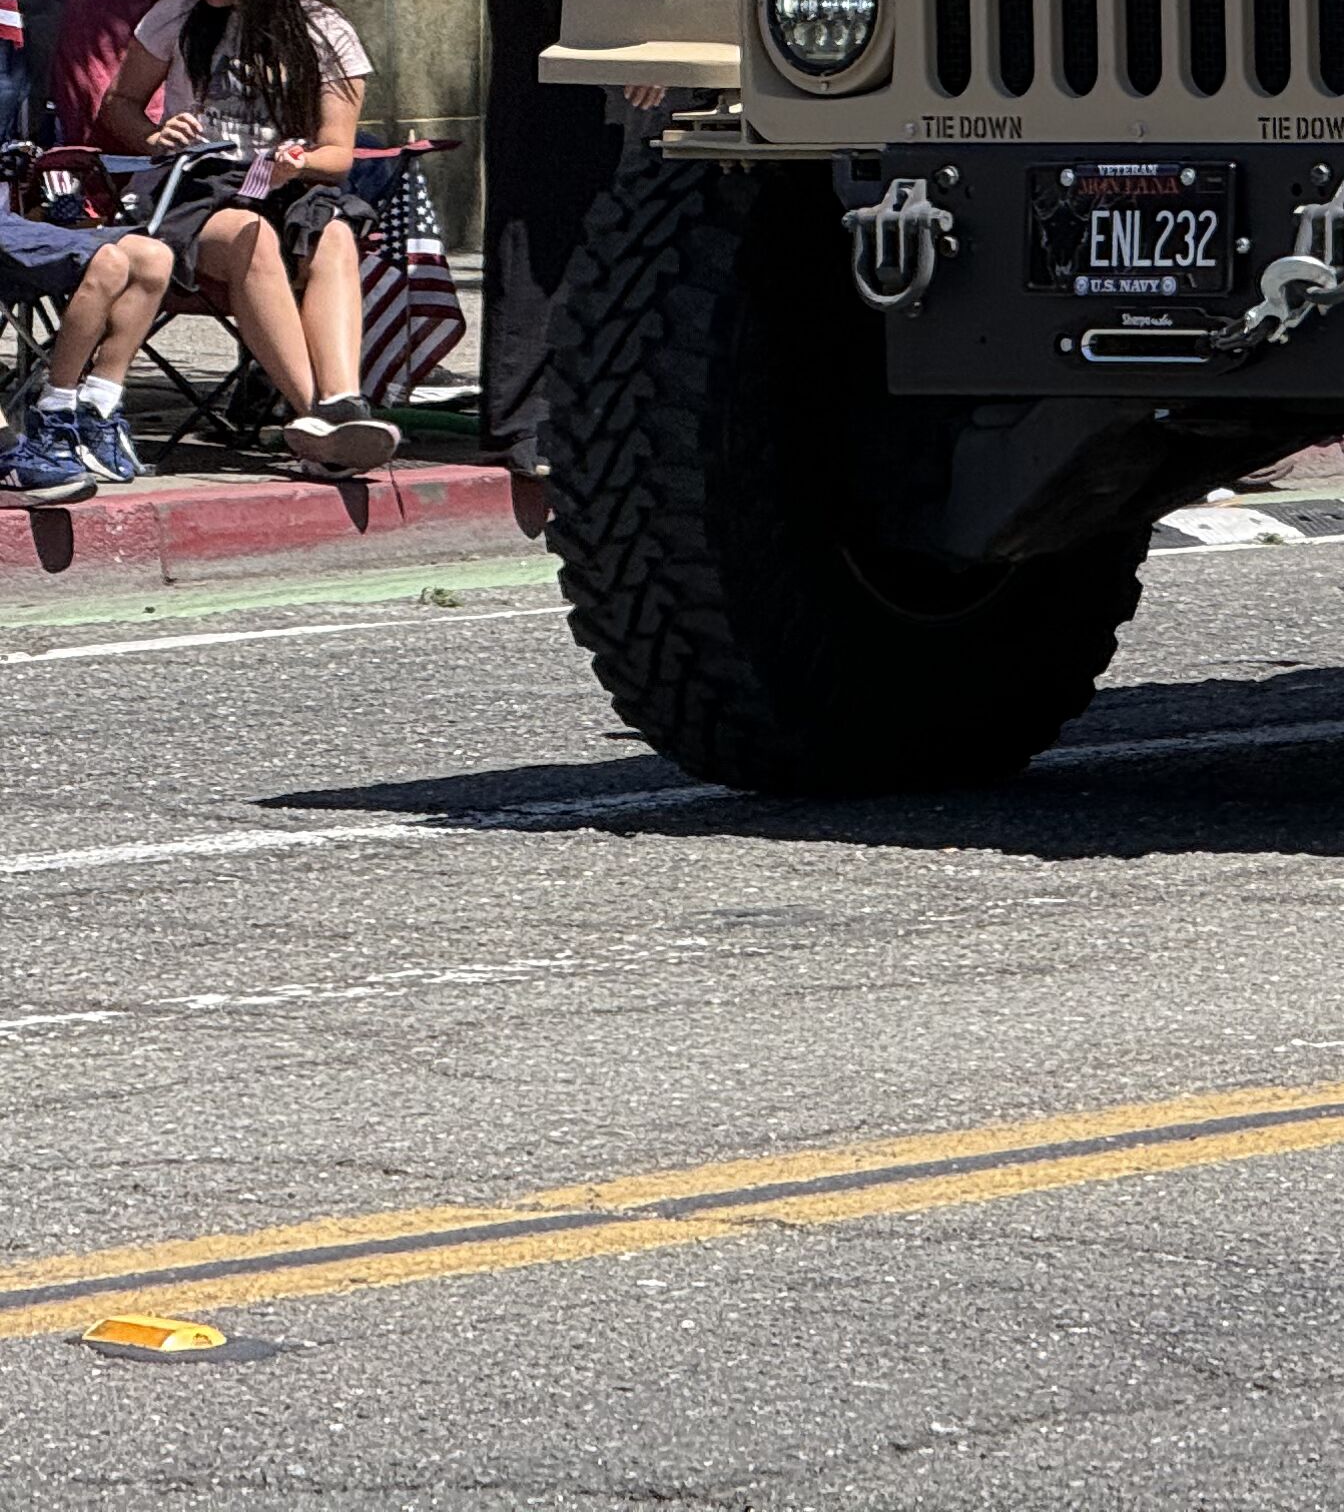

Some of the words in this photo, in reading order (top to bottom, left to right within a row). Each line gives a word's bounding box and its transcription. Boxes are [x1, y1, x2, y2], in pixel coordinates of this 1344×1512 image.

[921, 115, 955, 139] TIE
[959, 115, 1023, 140] DOWN
[1258, 116, 1291, 140] TIE
[1097, 163, 1159, 177] VETERAN
[1089, 209, 1218, 268] ENL232
[1090, 279, 1116, 293] U.S.
[1118, 279, 1161, 294] NAVY
